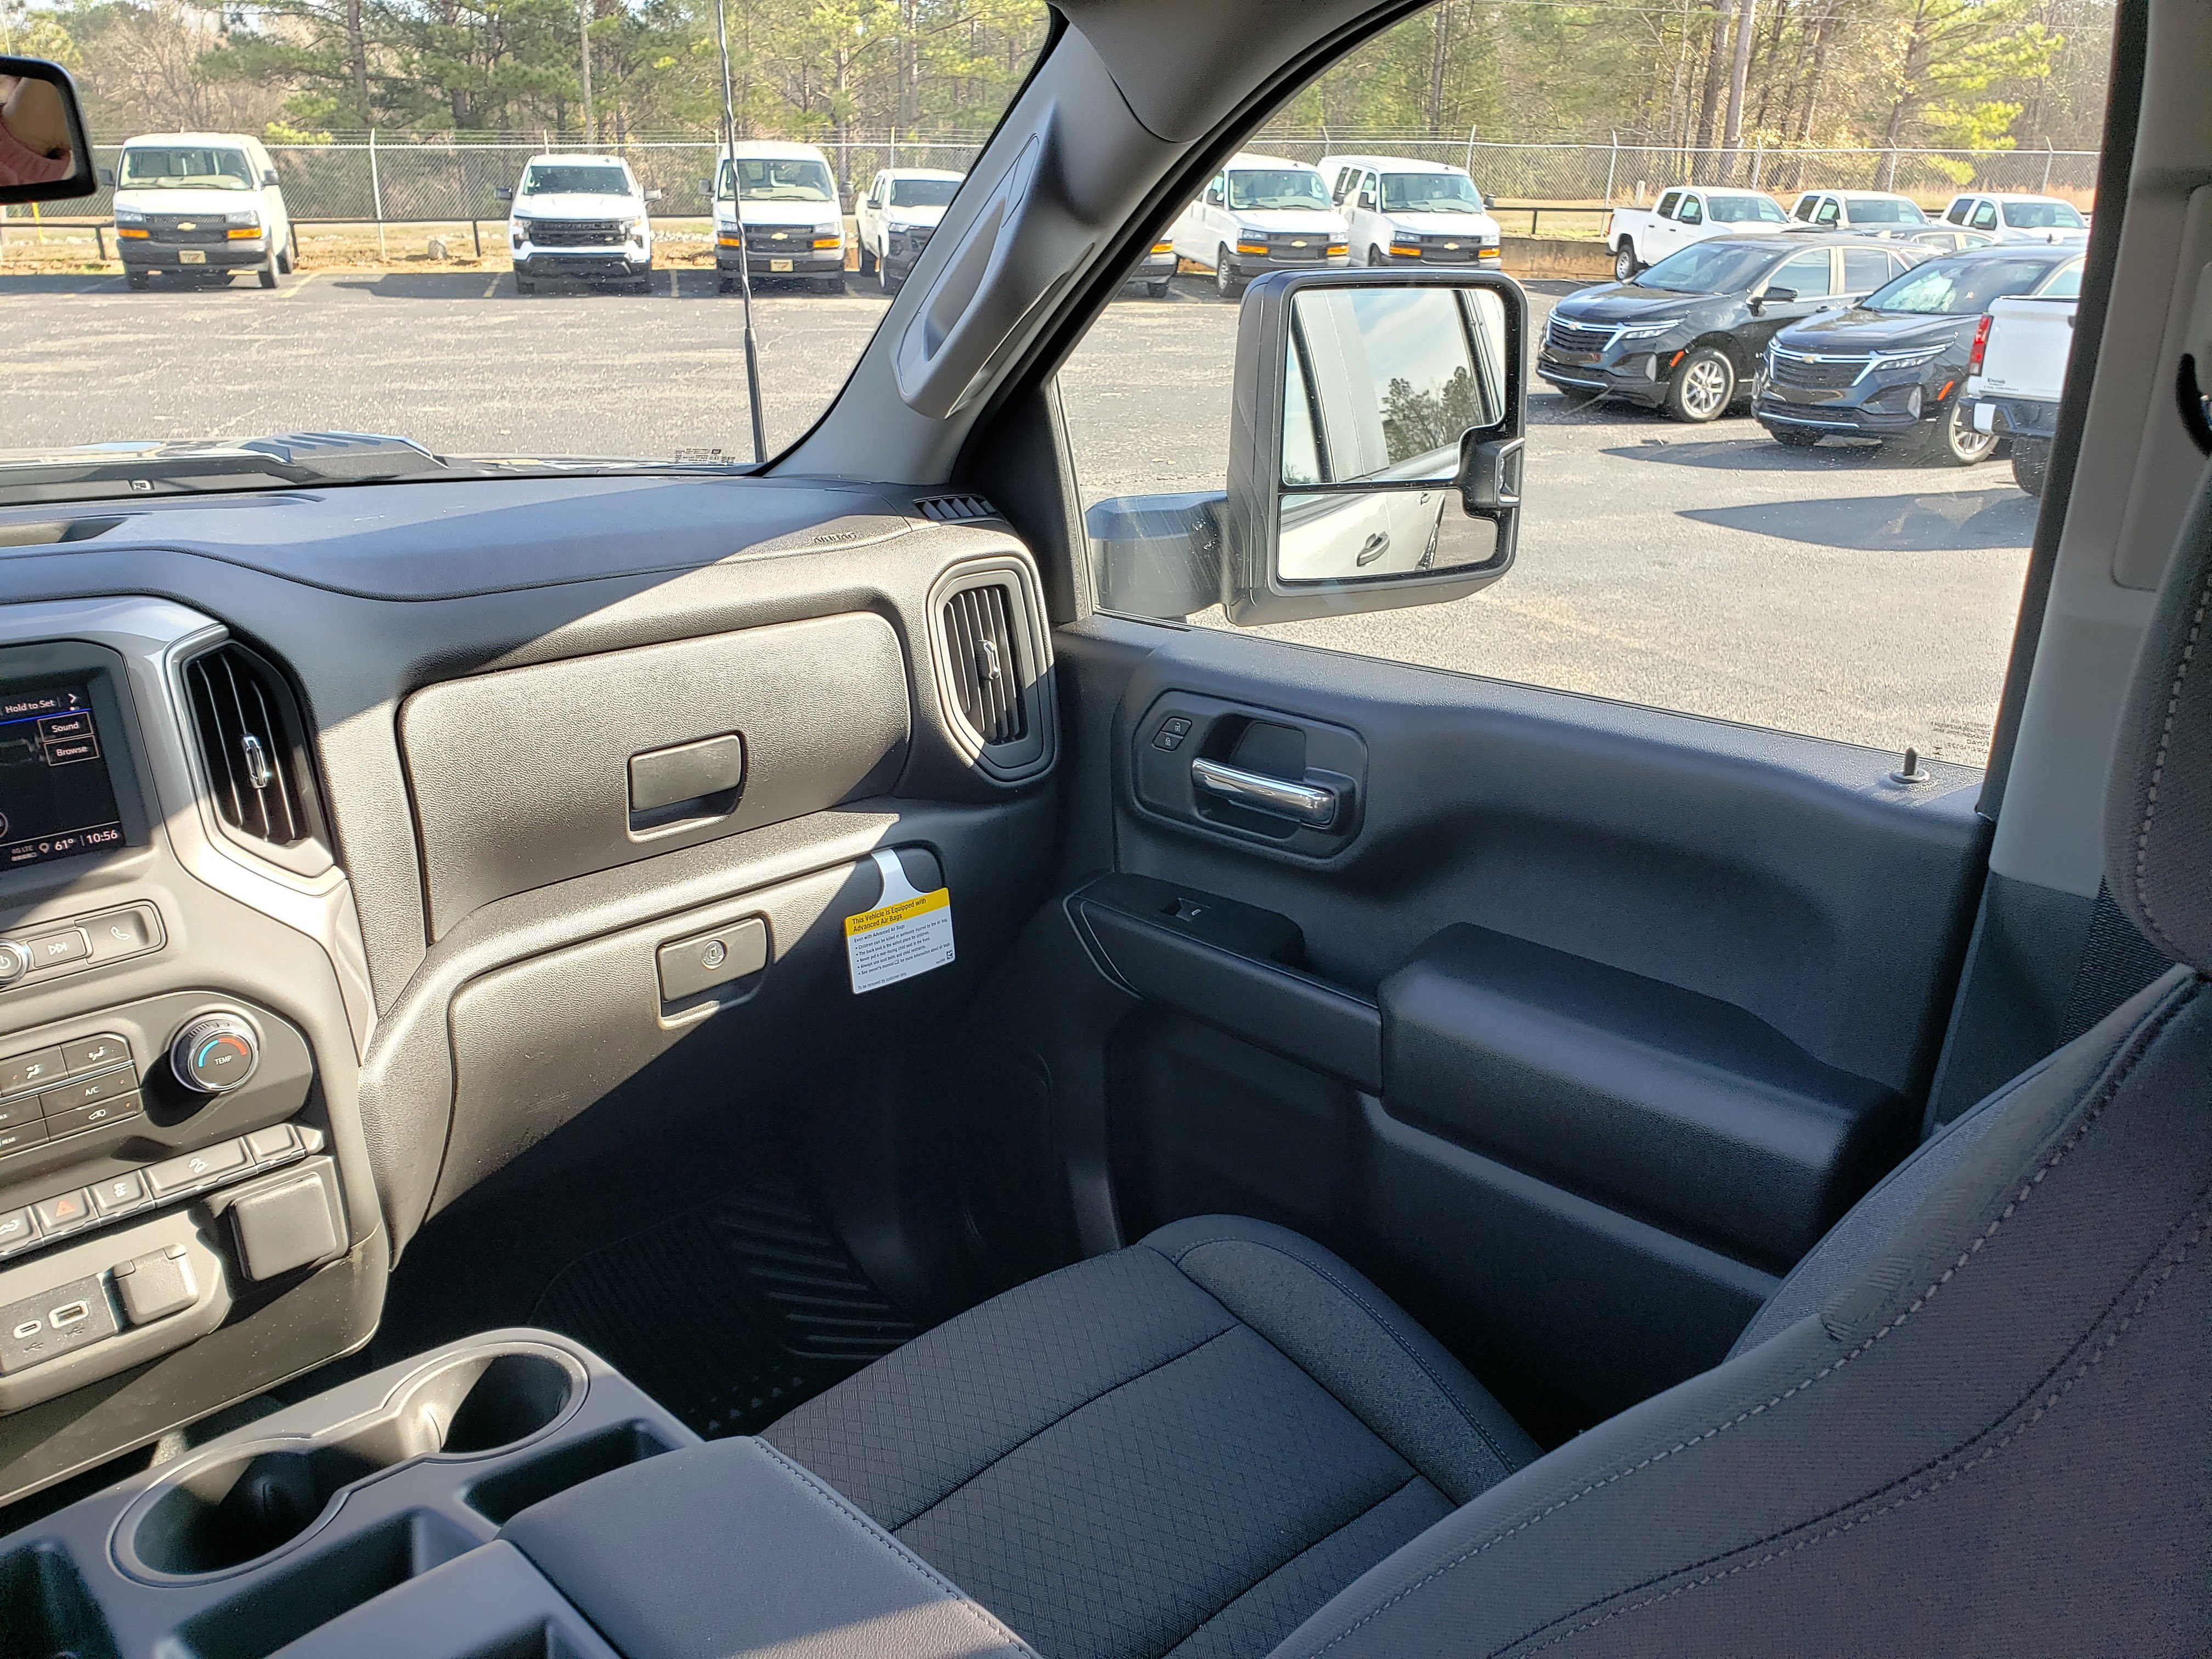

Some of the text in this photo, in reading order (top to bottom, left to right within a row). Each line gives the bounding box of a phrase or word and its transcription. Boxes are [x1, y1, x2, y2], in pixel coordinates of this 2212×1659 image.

[5, 703, 27, 713] Hold
[39, 699, 55, 708] Set
[52, 721, 79, 732] Sound
[57, 746, 88, 757] Browse
[86, 830, 117, 844] 10:56
[865, 911, 884, 921] Vehicle
[891, 901, 915, 913] Equipped
[853, 919, 880, 932] Advanced
[889, 913, 902, 922] Bags
[873, 928, 890, 937] Advanced
[214, 1055, 232, 1065] TEMP
[85, 1086, 100, 1096] A/C
[2, 1137, 16, 1145] REAR
